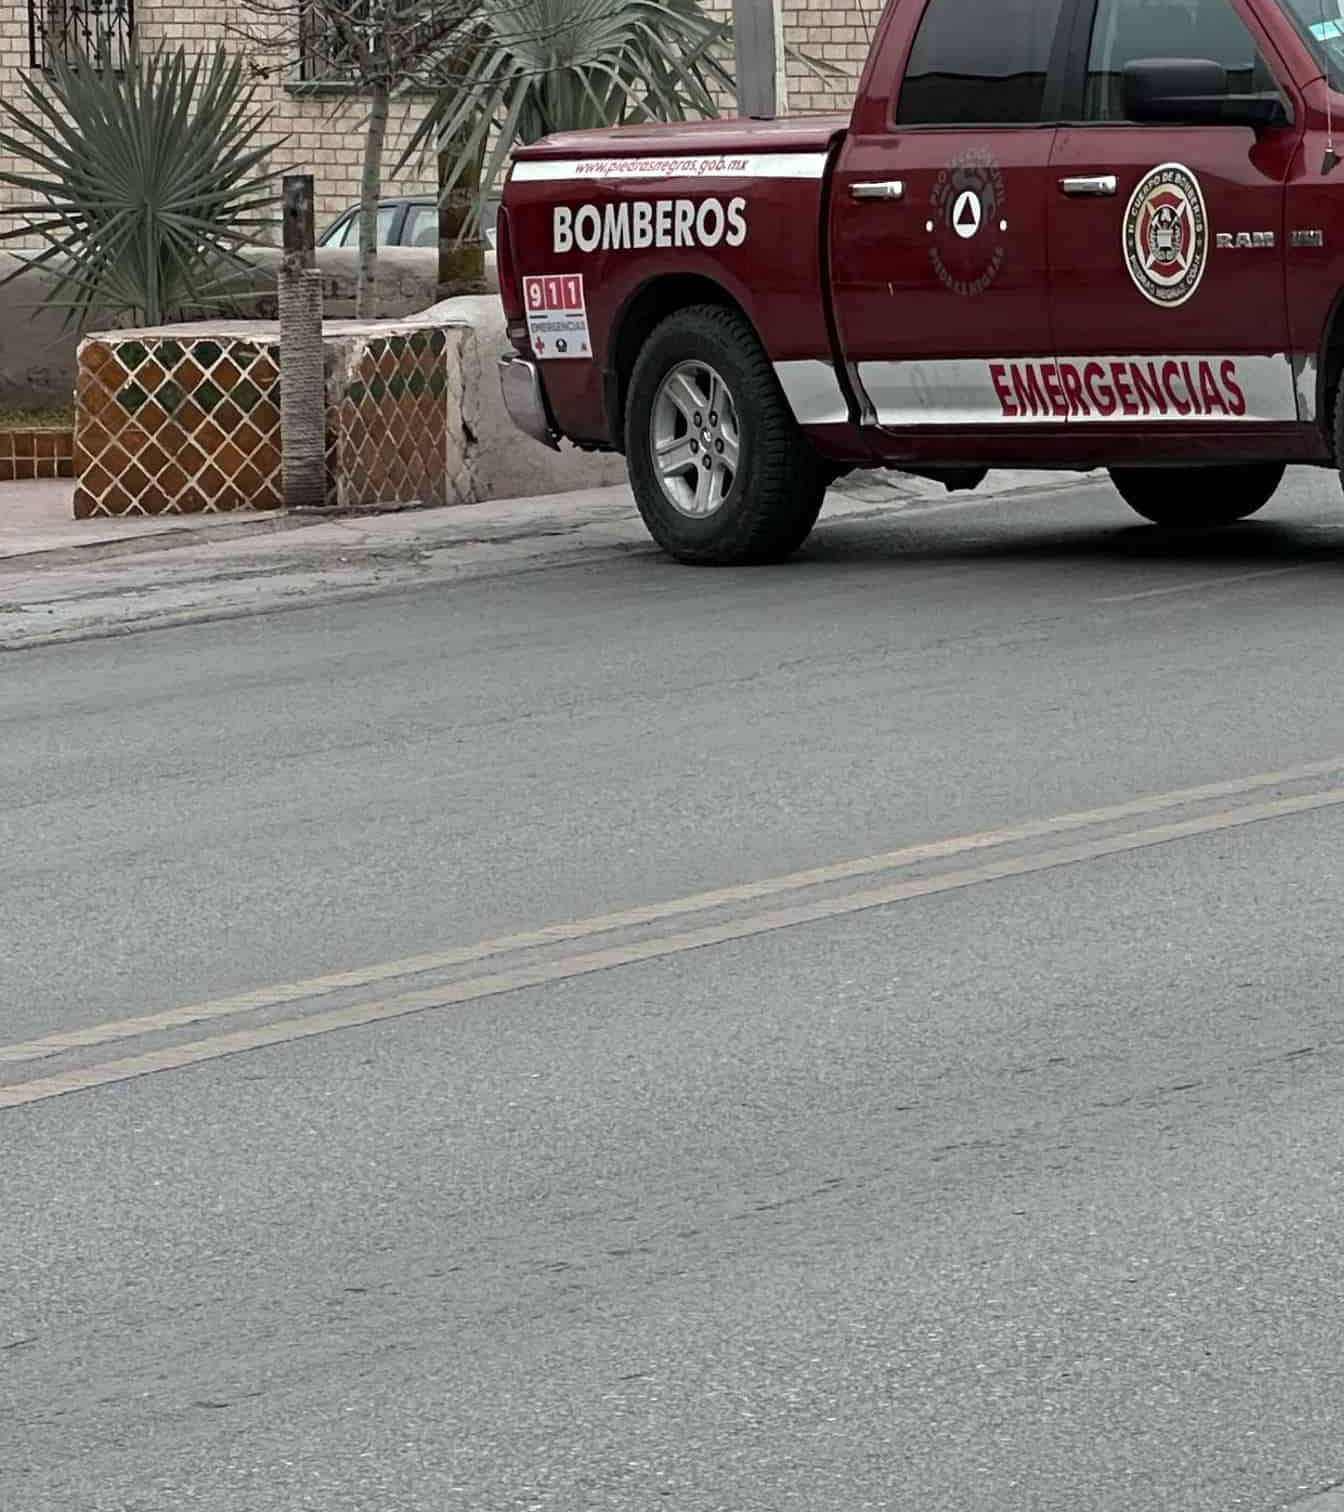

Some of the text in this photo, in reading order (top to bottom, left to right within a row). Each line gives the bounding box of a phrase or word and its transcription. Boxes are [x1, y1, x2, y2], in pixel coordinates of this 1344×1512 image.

[553, 196, 747, 253] BOMBEROS
[1216, 231, 1275, 249] RAM
[989, 359, 1246, 417] EMERGENCIAS
